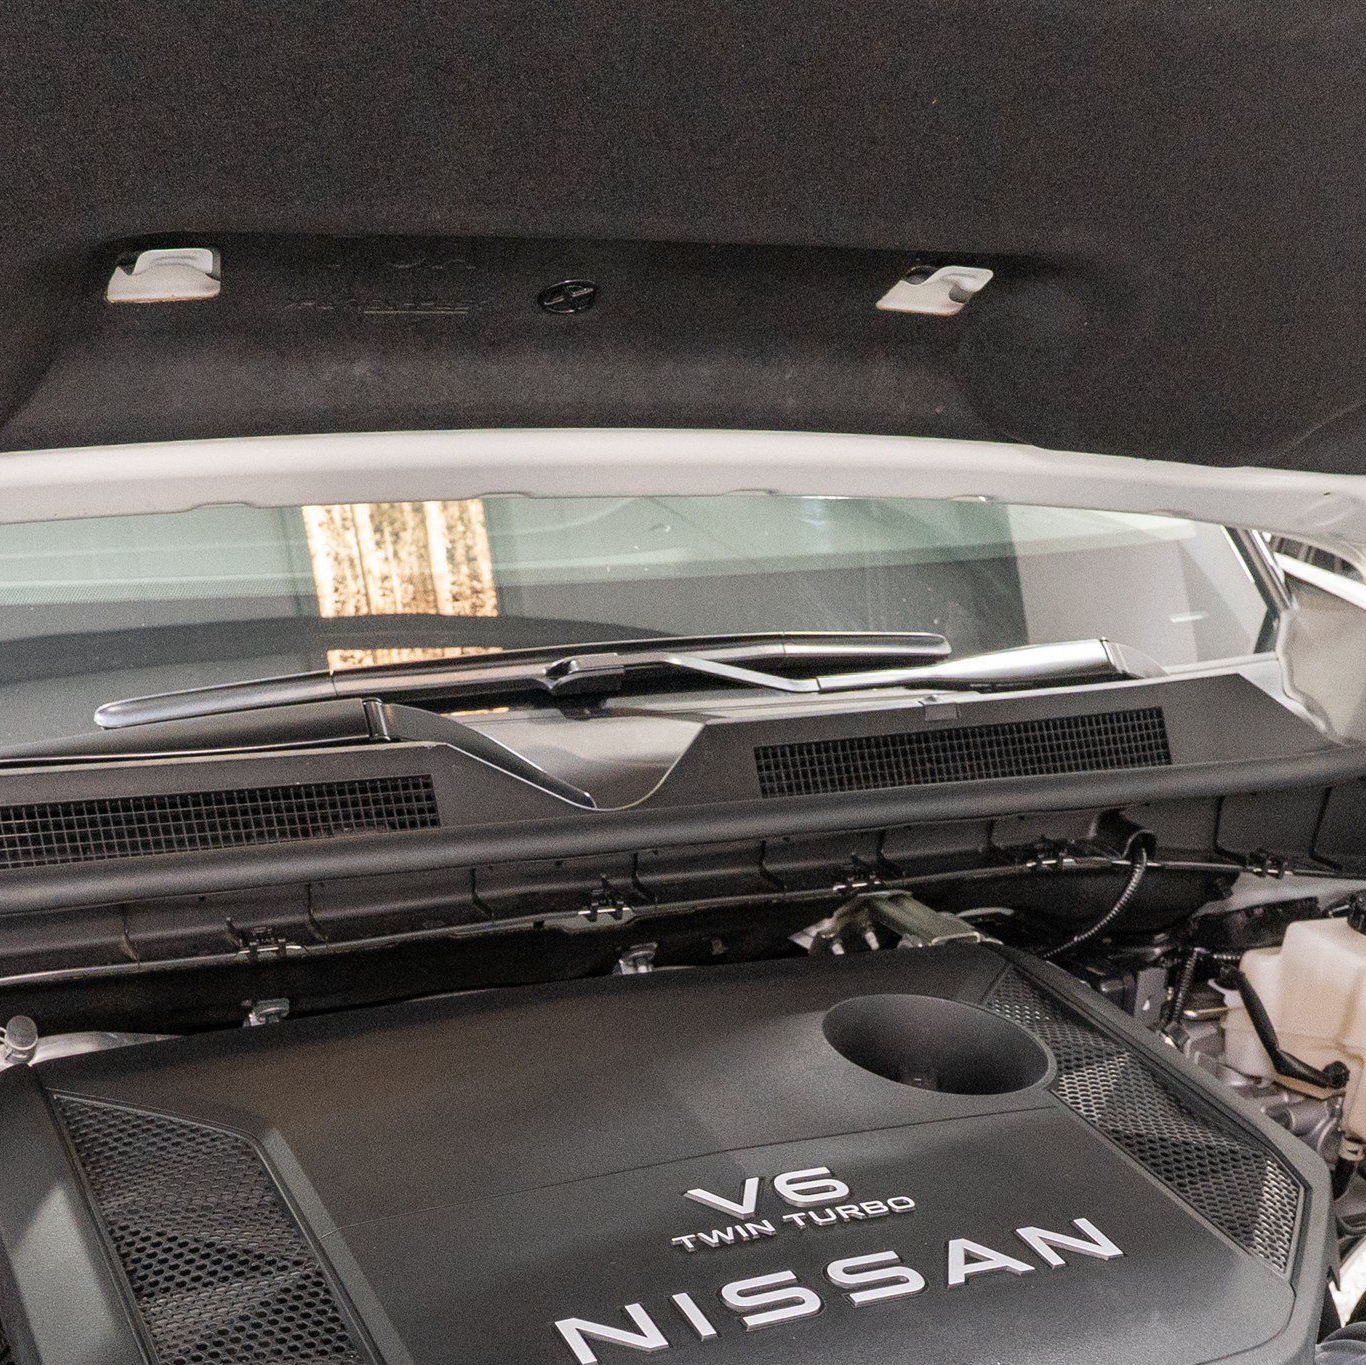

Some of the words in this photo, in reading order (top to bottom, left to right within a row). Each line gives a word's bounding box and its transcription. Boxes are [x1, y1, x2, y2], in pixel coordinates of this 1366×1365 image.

[684, 1165, 850, 1221] V6
[671, 1219, 777, 1252] TWIN
[782, 1195, 916, 1231] TURBO
